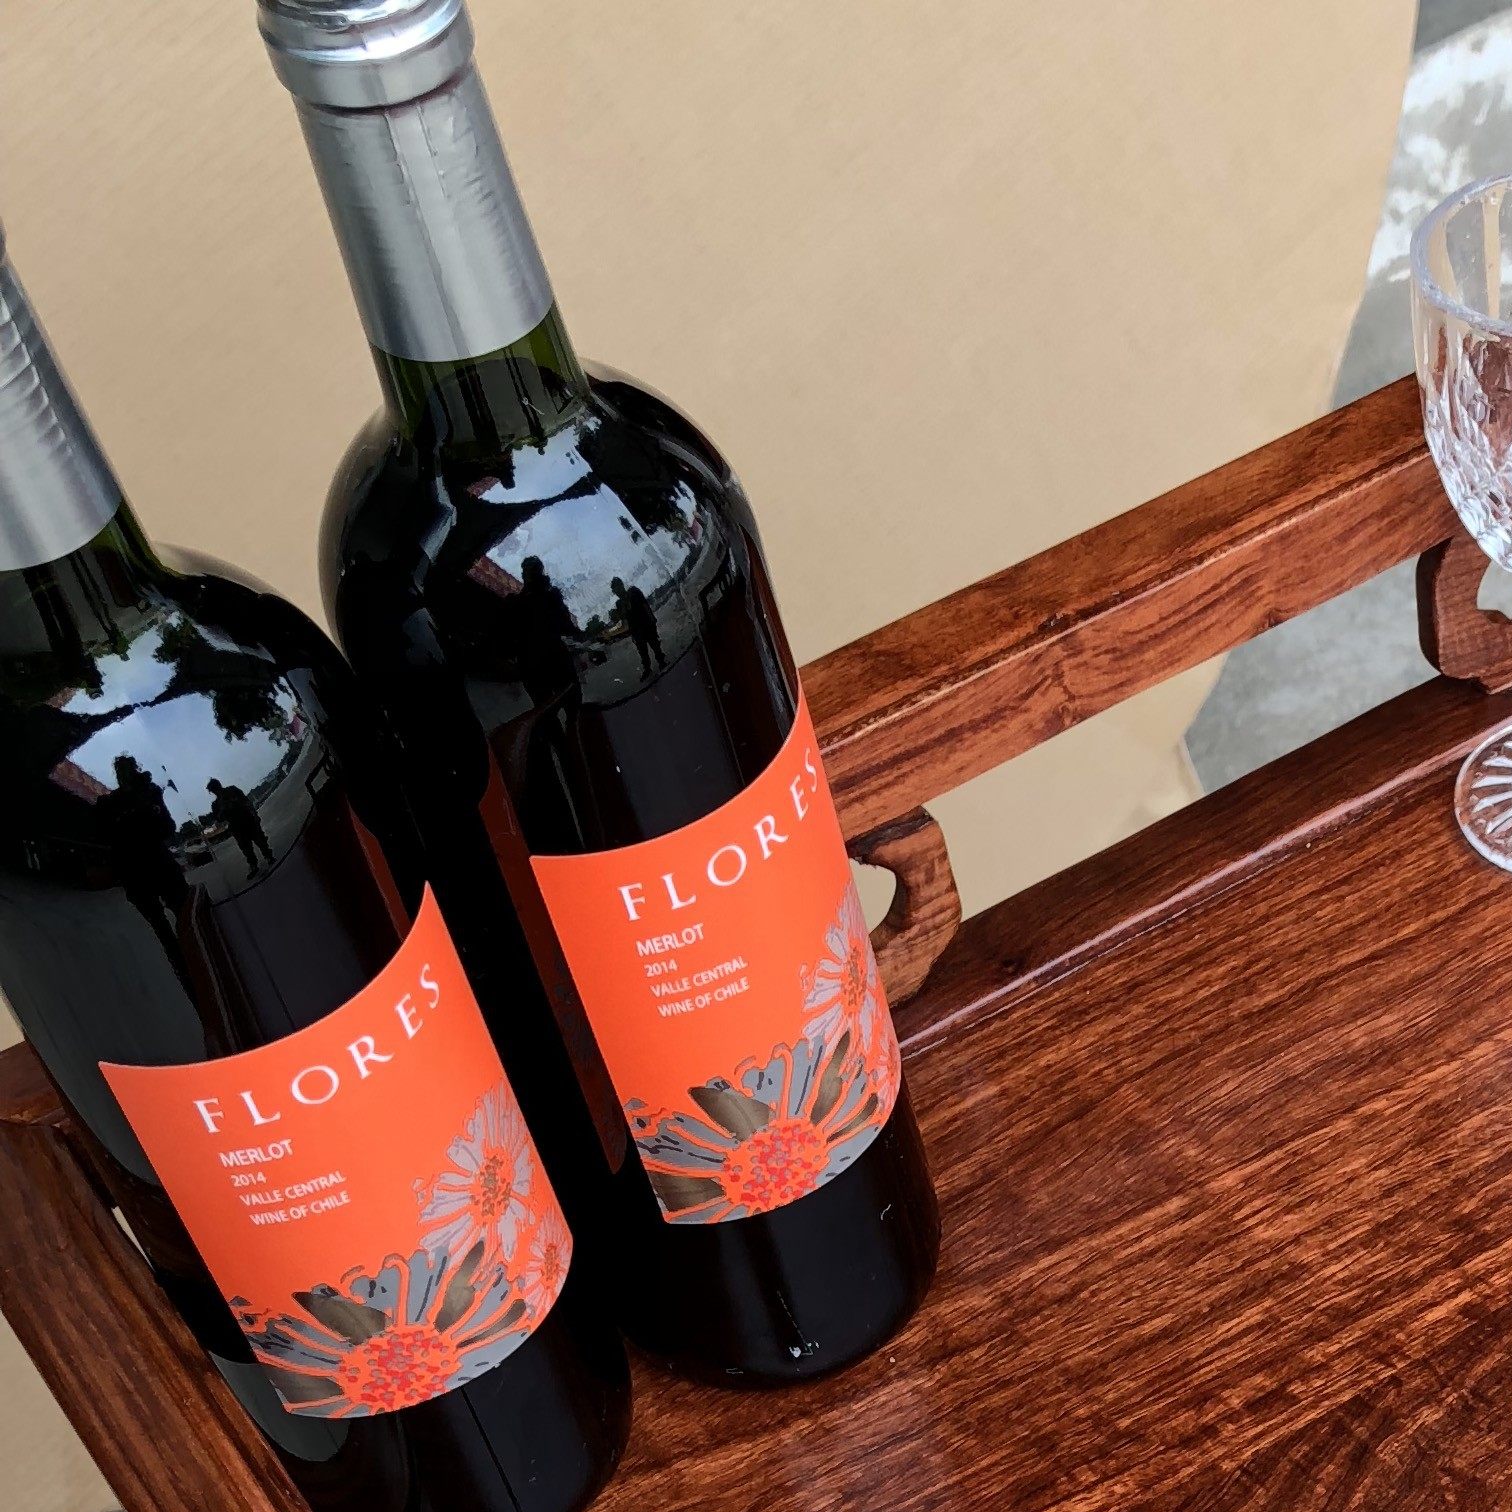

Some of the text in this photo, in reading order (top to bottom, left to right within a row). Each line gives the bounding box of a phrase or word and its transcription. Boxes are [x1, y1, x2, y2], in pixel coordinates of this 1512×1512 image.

[618, 747, 819, 921] FLORES
[636, 922, 704, 957] MERLOT
[644, 959, 678, 978] 2014
[650, 955, 748, 998] VALLE CENTRAL
[657, 976, 750, 1017] WINE OF CHILE
[193, 963, 441, 1134] FLORES
[219, 1138, 293, 1168] MERLOT
[230, 1171, 267, 1188] 2014
[239, 1170, 347, 1206] VALLE CENTRAL
[248, 1190, 351, 1226] WINE OF CHILE
